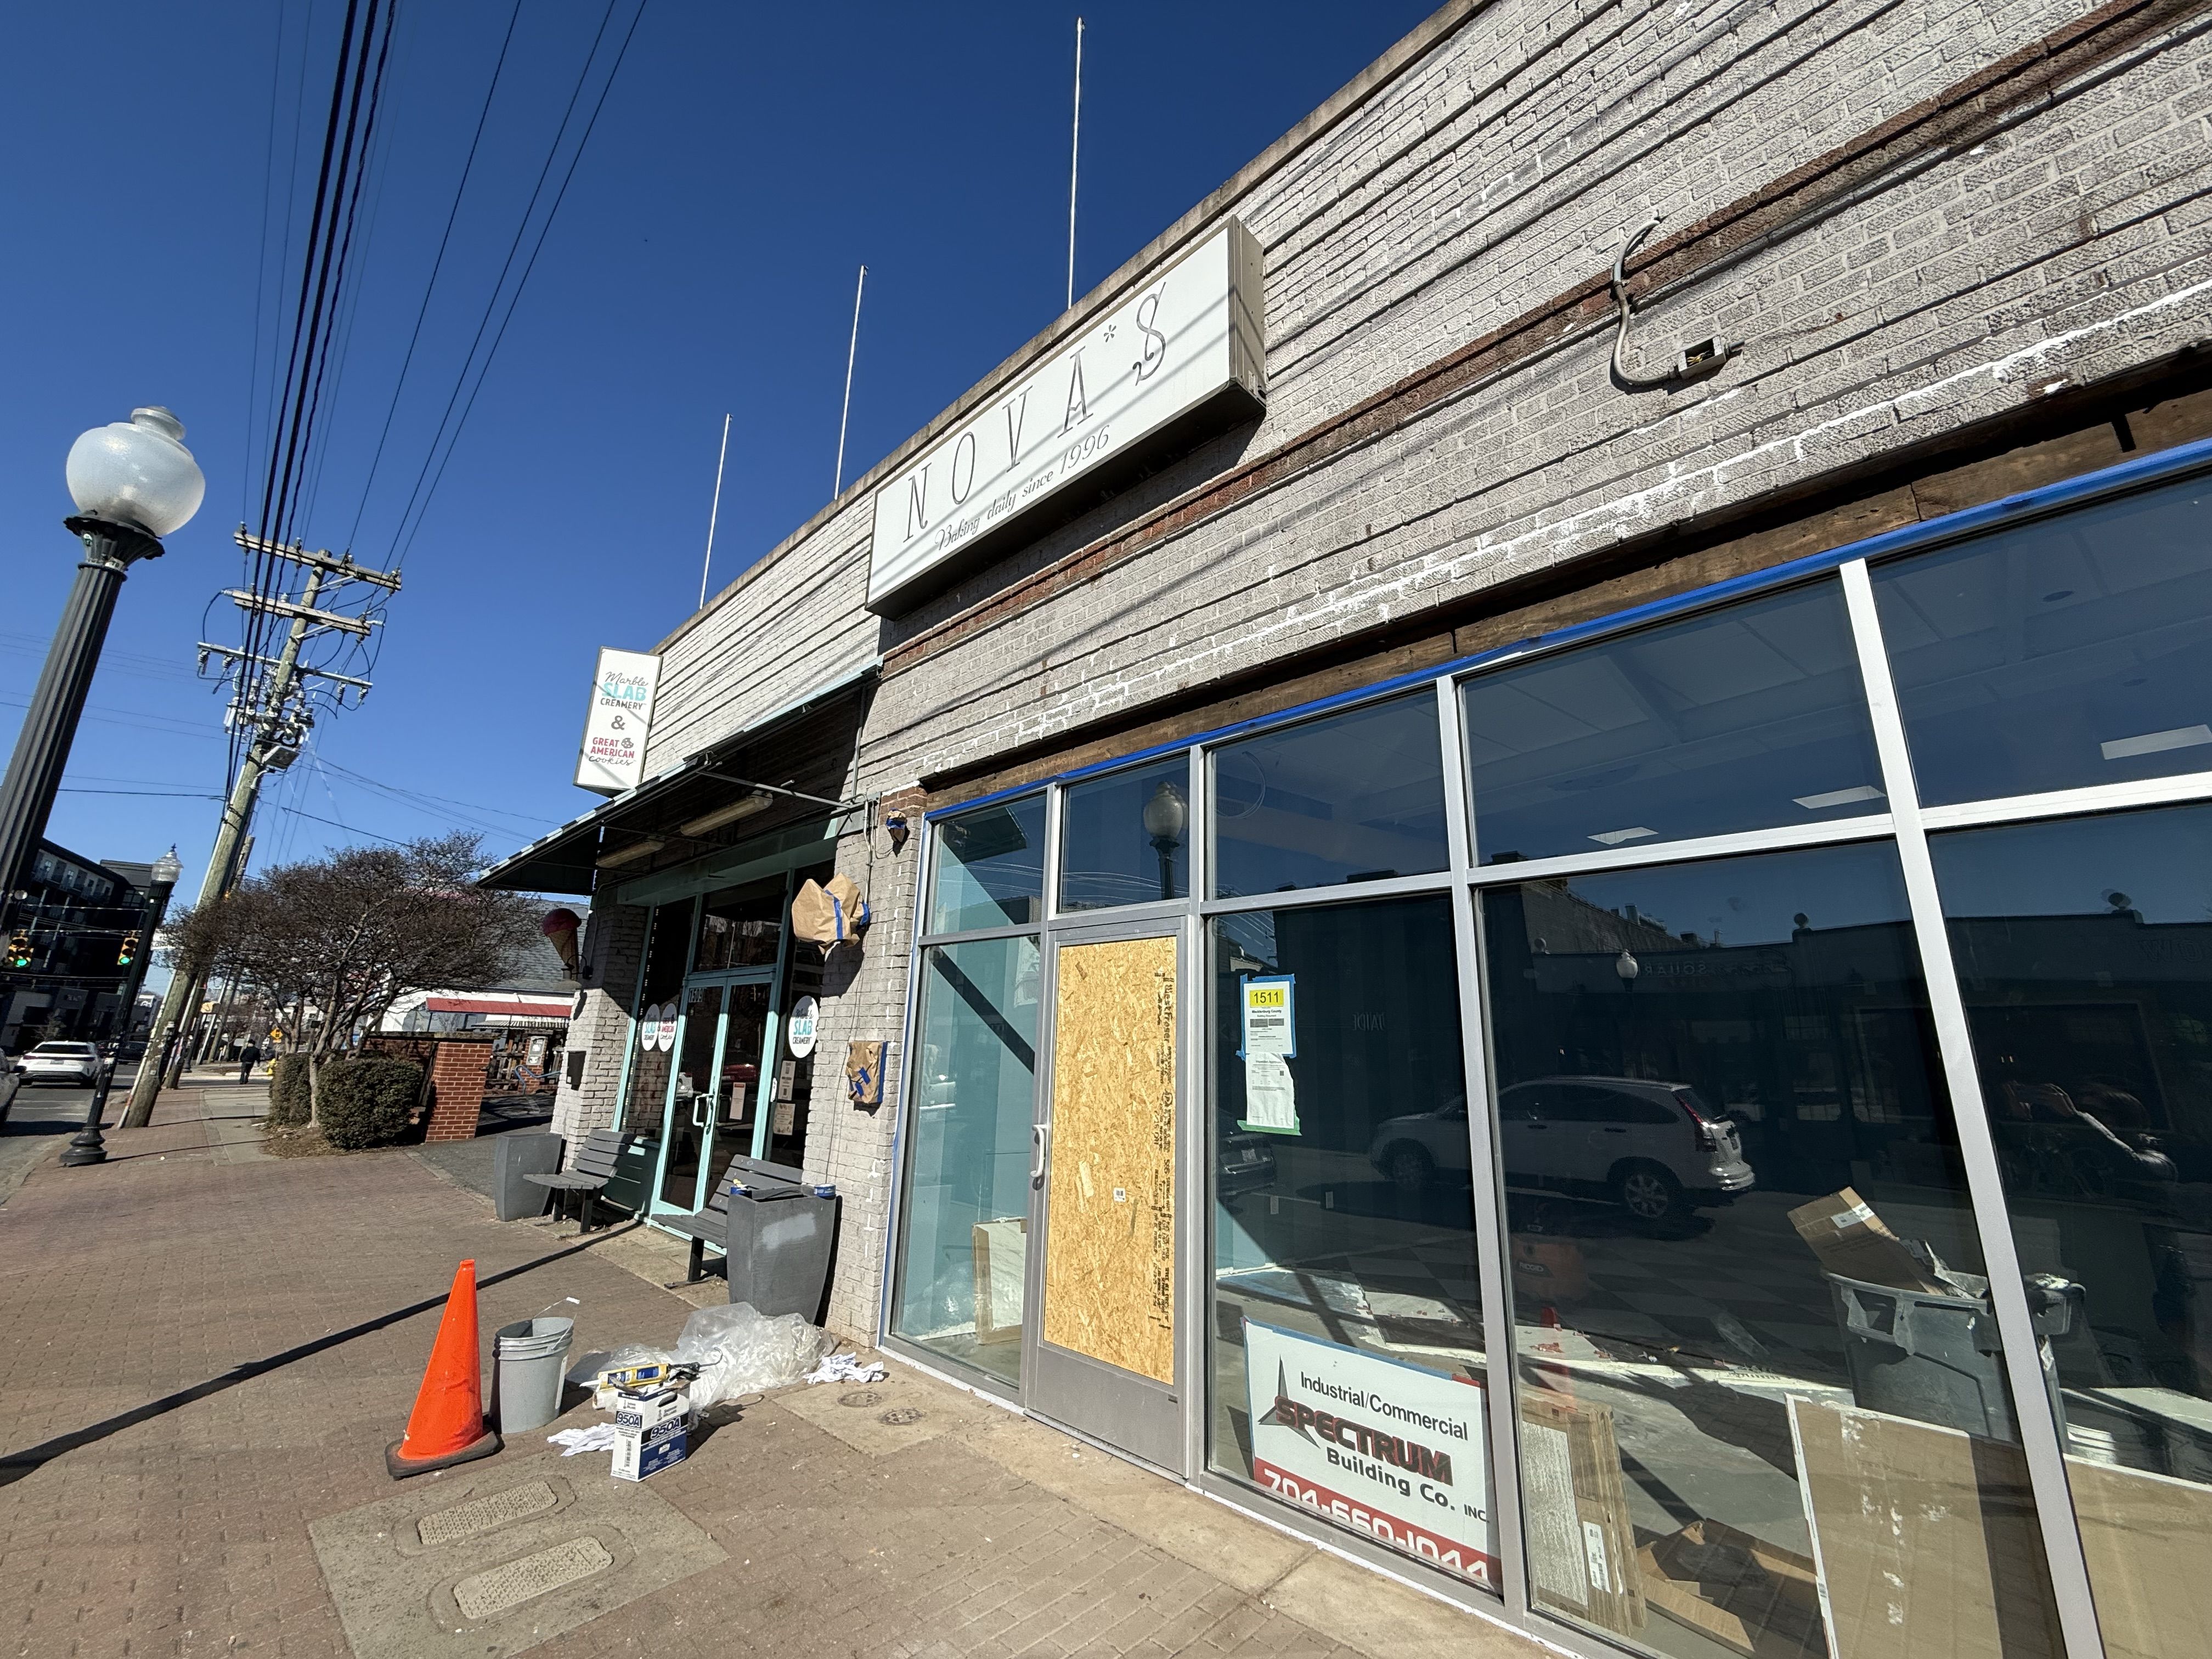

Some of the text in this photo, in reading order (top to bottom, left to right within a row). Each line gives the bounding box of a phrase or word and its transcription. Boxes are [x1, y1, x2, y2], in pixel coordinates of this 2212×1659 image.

[935, 425, 1110, 551] Baking daily since 1996
[605, 672, 649, 686] Marble
[602, 682, 647, 701] SLAB
[600, 697, 644, 710] CREAMERY
[611, 715, 626, 731] &
[592, 737, 619, 748] GREAT
[590, 746, 635, 759] AMERICAN
[1254, 991, 1278, 1003] 1511
[793, 1020, 812, 1035] SLAB
[1301, 1370, 1469, 1441] Industrial/Commercial
[617, 1412, 641, 1428] 950A
[650, 1416, 681, 1440] 950A
[1274, 1394, 1454, 1487] SPECTRUM
[1327, 1446, 1411, 1497] Building
[1420, 1482, 1455, 1511] Co.
